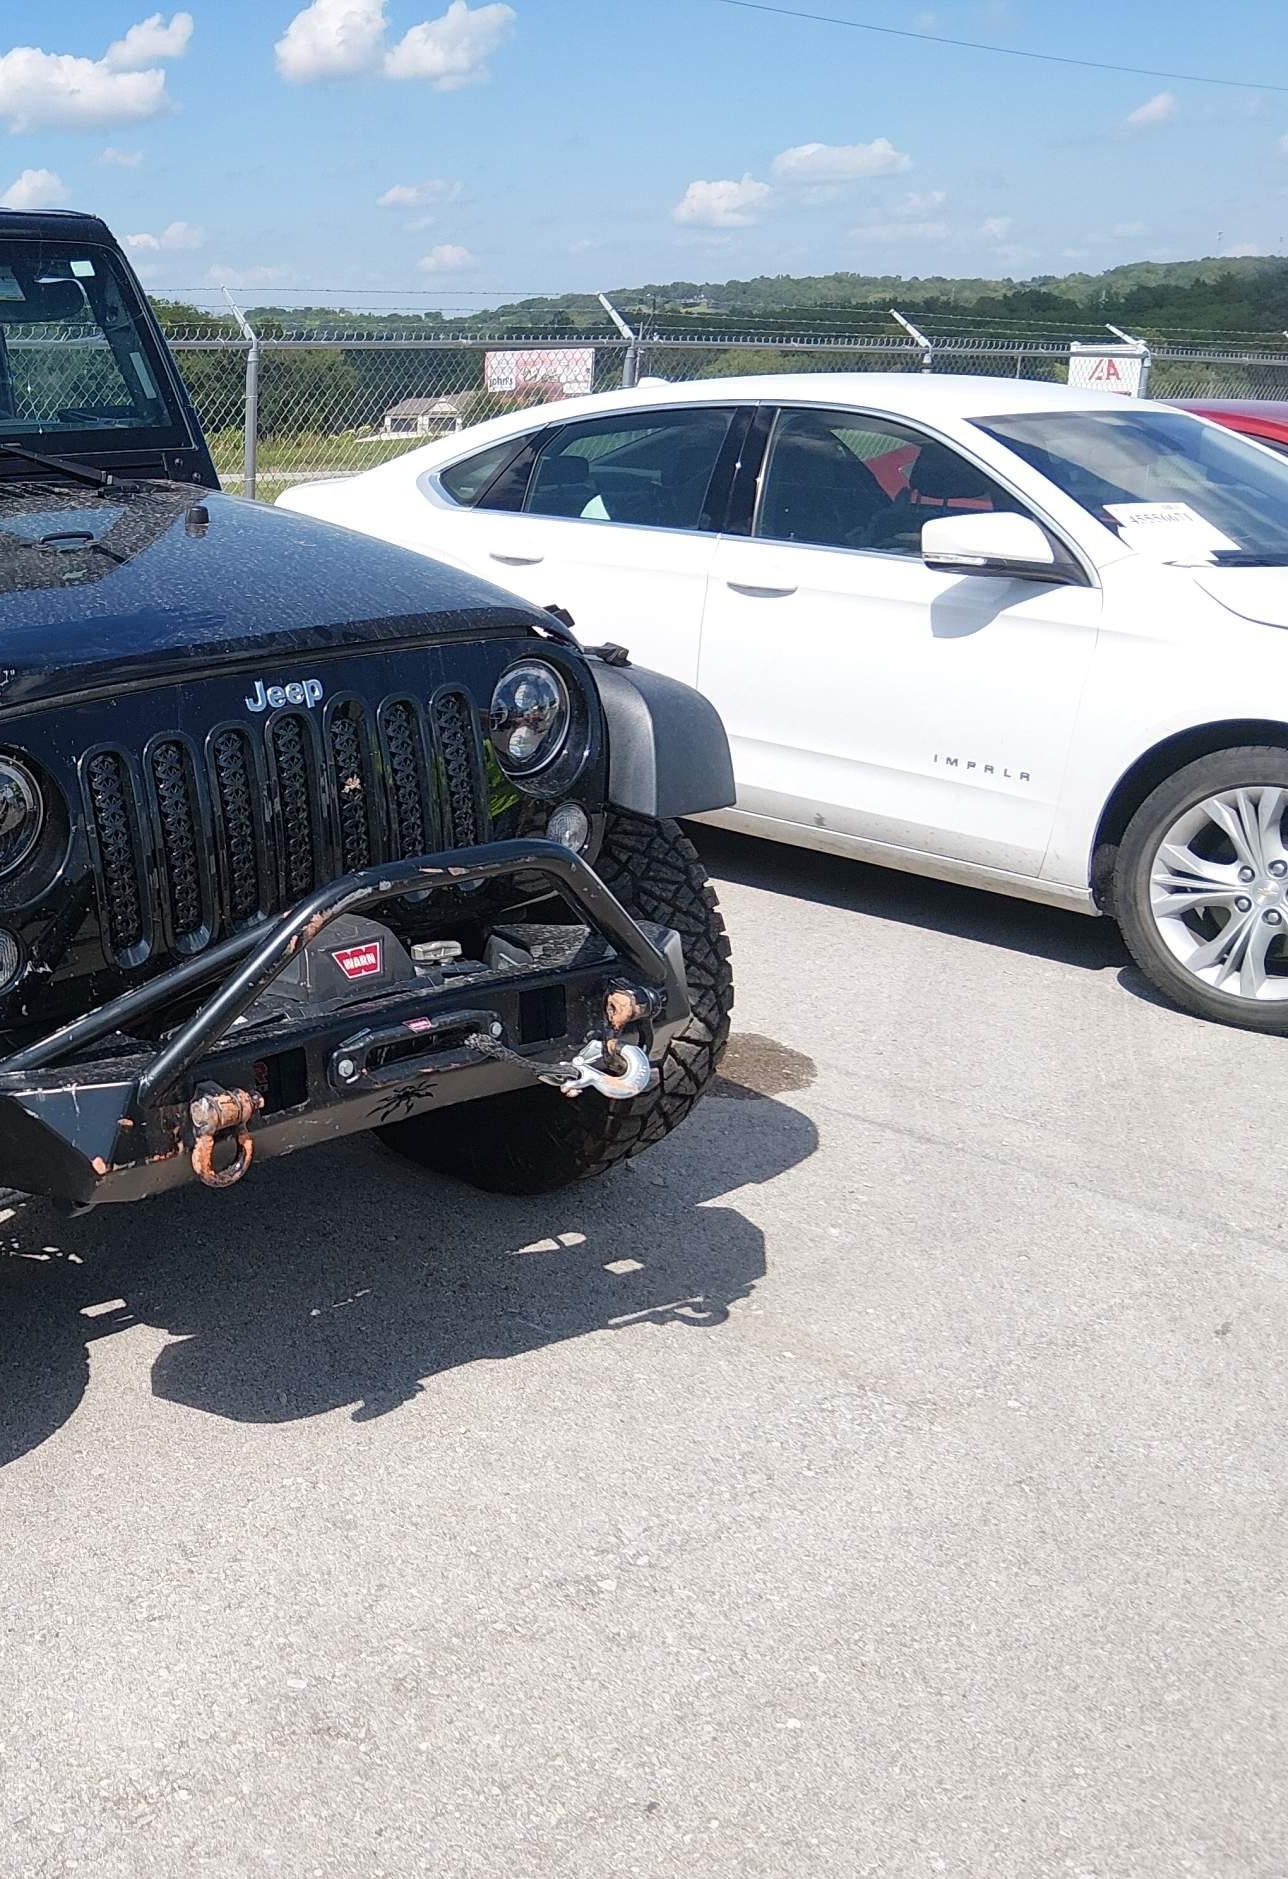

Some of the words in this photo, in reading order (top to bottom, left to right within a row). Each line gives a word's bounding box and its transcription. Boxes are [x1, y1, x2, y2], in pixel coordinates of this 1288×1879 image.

[244, 679, 324, 712] Jeep
[933, 754, 1031, 782] IMPALA
[342, 952, 377, 971] WARN
